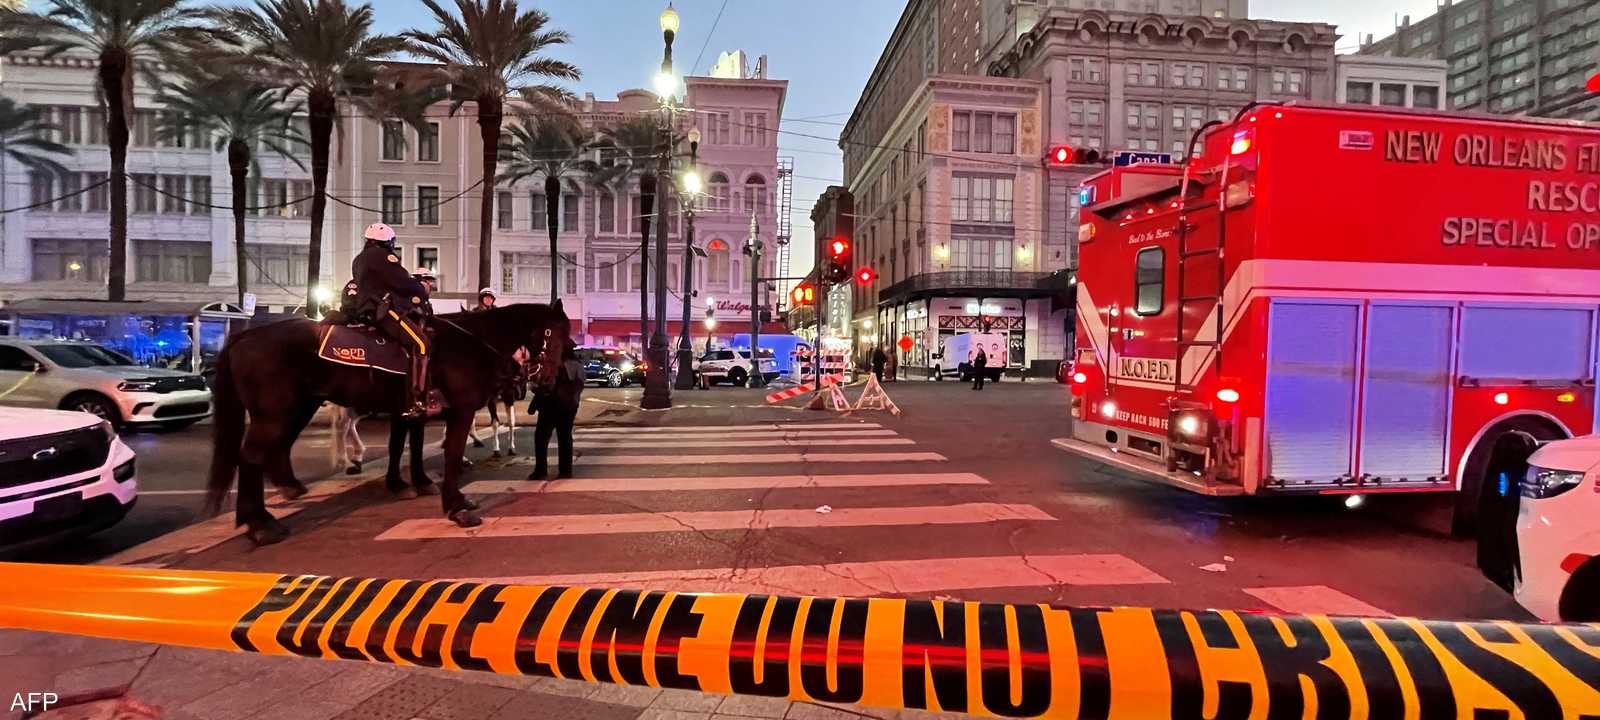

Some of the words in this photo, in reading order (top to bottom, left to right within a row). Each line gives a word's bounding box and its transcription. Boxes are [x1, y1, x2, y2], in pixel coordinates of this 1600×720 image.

[1128, 153, 1162, 165] Canal
[1385, 130, 1443, 163] NEW
[1453, 133, 1567, 171] ORLEANS
[1576, 143, 1600, 175] FI
[1528, 180, 1600, 214] RESC
[1441, 216, 1556, 249] SPECIAL
[1566, 221, 1600, 251] OP
[1120, 358, 1174, 381] N.O.F.D.
[1161, 419, 1169, 431] FE
[230, 574, 509, 673] POLICE
[514, 585, 705, 693] LINE
[902, 599, 1114, 719] NOT
